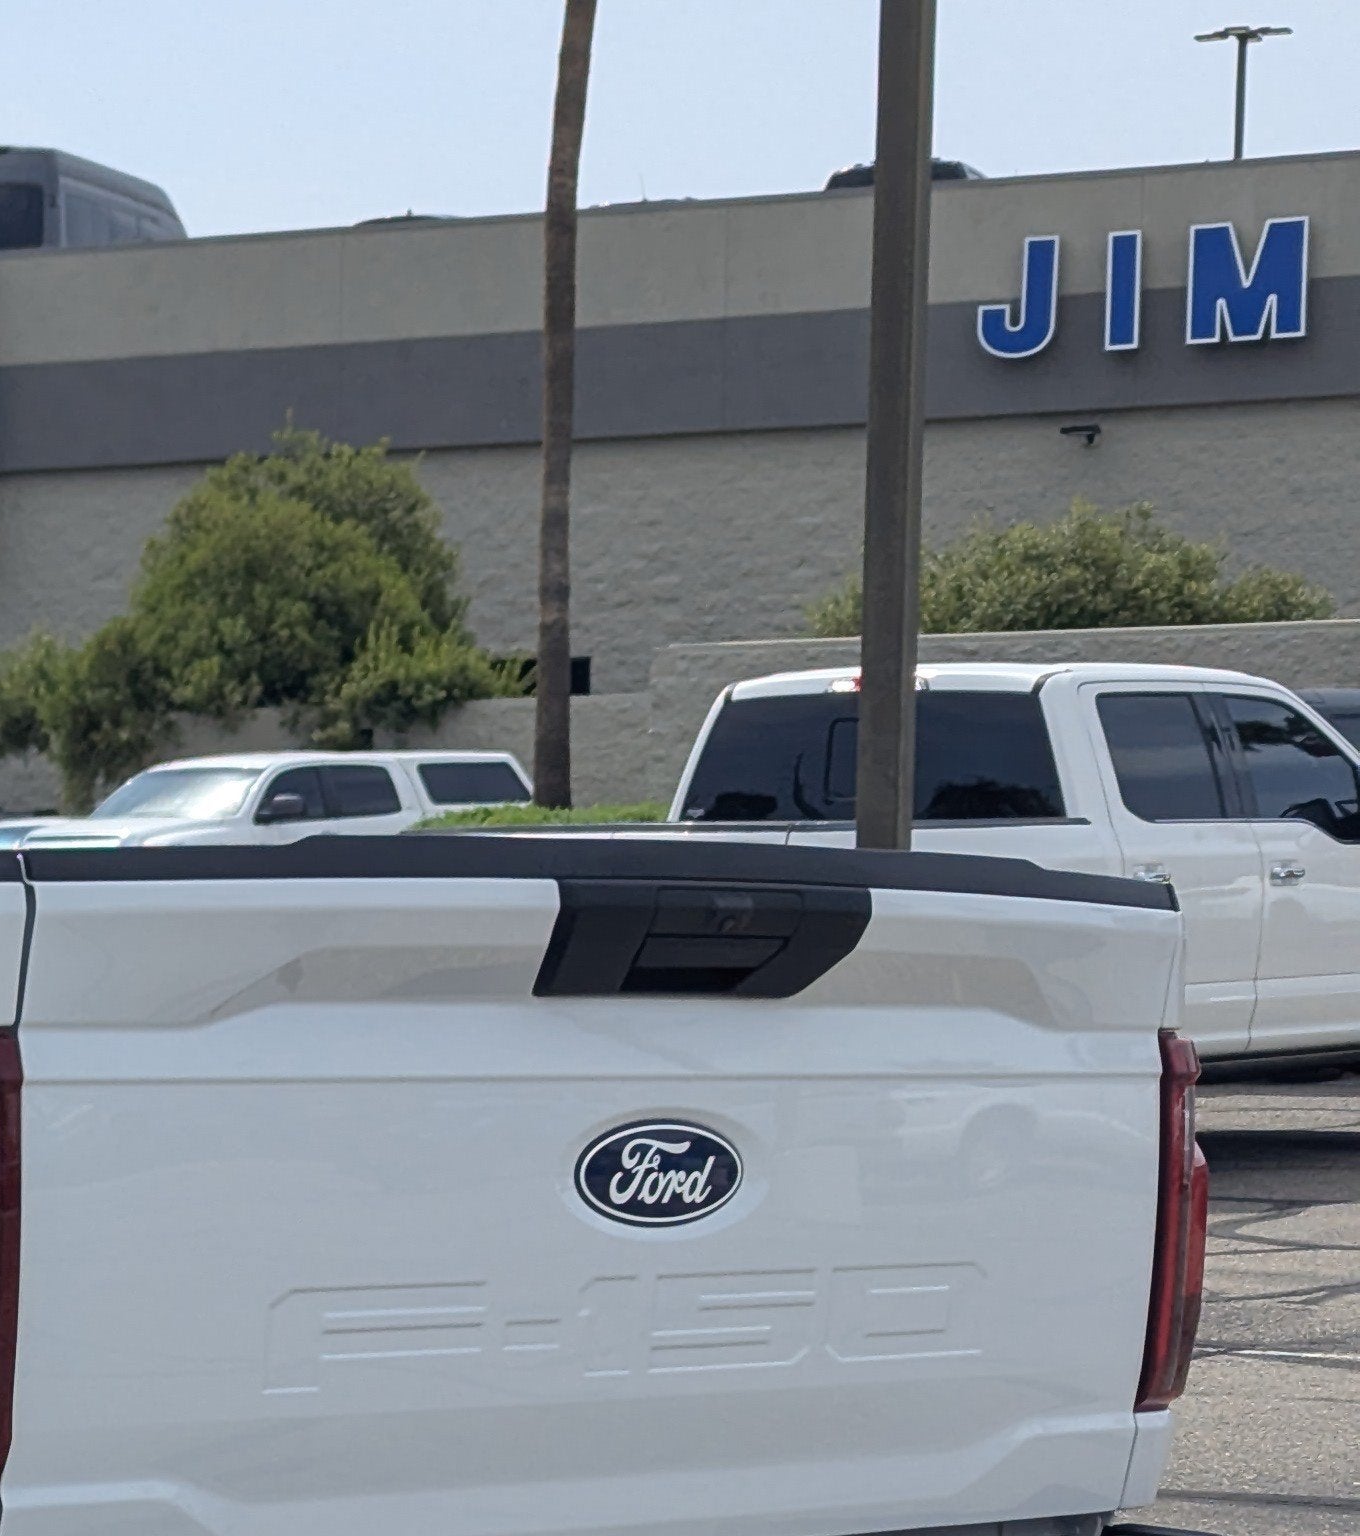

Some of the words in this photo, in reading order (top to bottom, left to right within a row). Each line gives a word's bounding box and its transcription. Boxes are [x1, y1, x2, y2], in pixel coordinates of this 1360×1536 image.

[977, 215, 1310, 359] JIM
[609, 1138, 716, 1205] Ford
[264, 1261, 986, 1395] F-150
